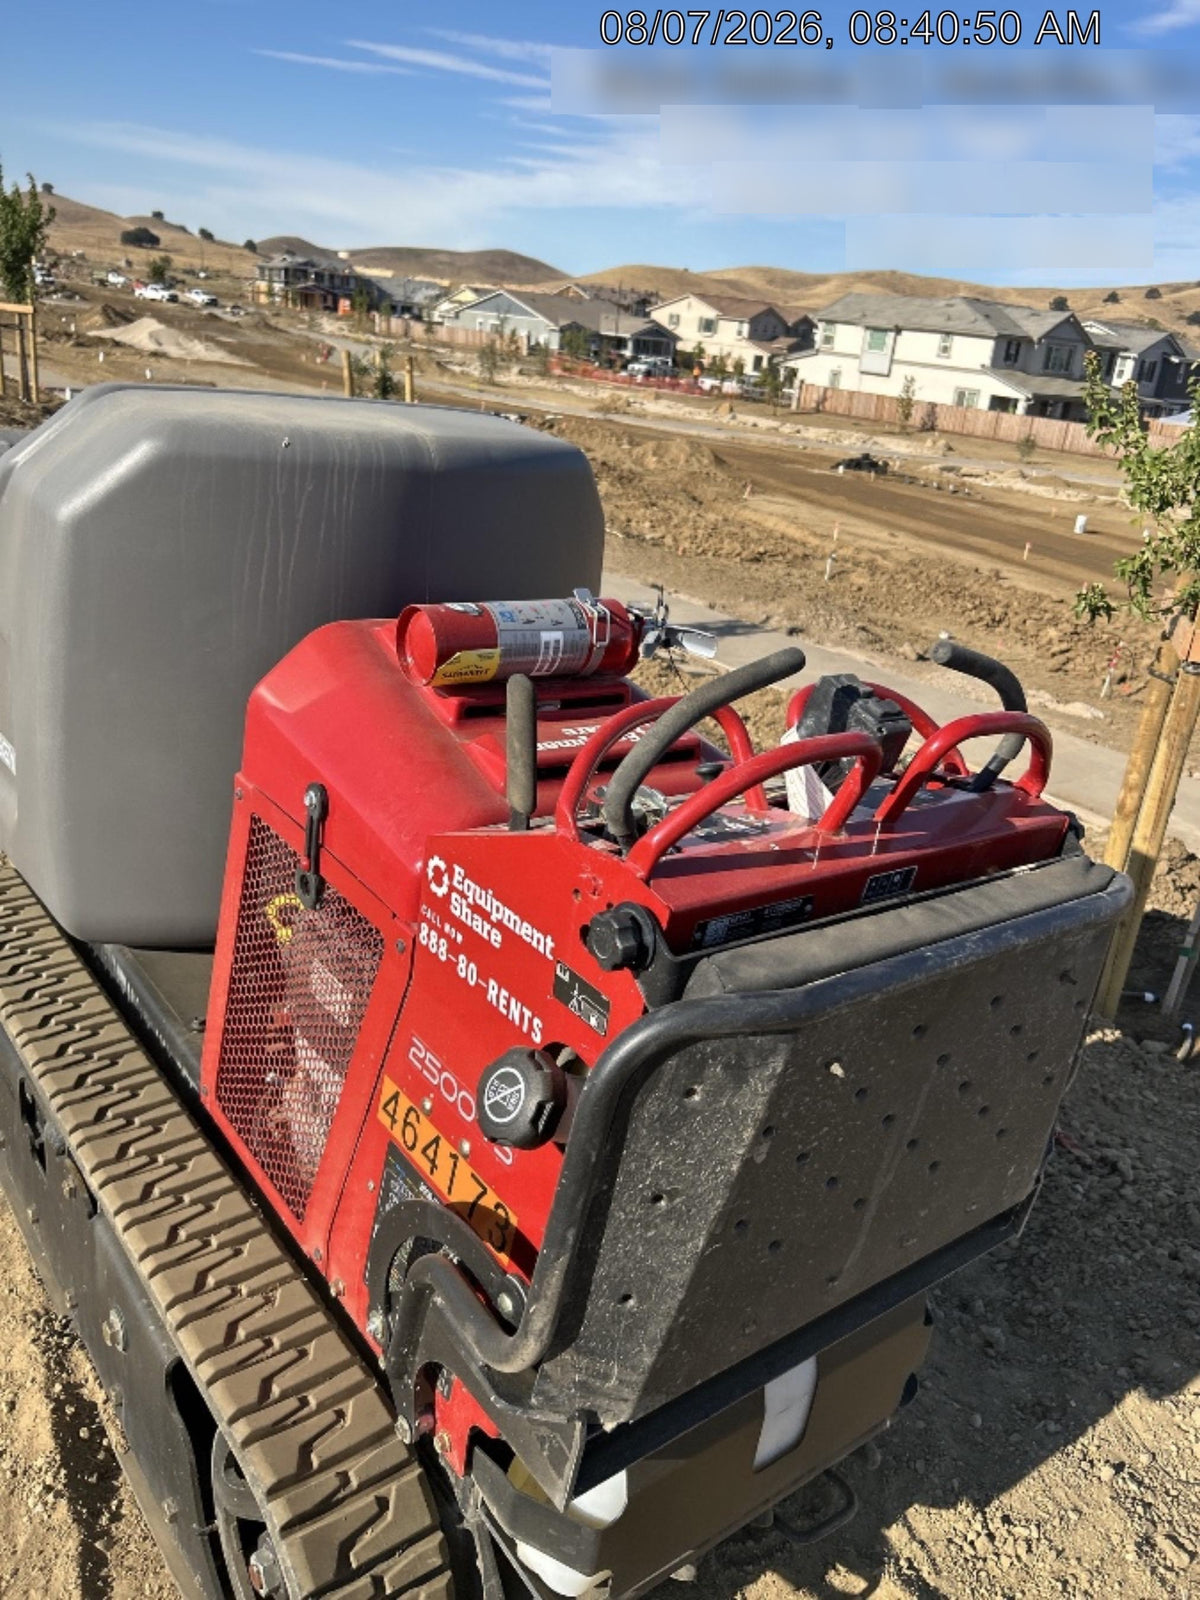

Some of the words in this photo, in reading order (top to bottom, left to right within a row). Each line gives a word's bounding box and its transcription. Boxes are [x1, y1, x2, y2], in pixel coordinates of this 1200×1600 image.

[421, 903, 442, 929] CALL
[444, 921, 463, 945] NOW
[450, 892, 502, 949] Share
[453, 863, 555, 960] Equipment
[418, 922, 544, 1044] 888-80-RENTS
[408, 1040, 477, 1122] 2500
[381, 1090, 511, 1254] 464173
